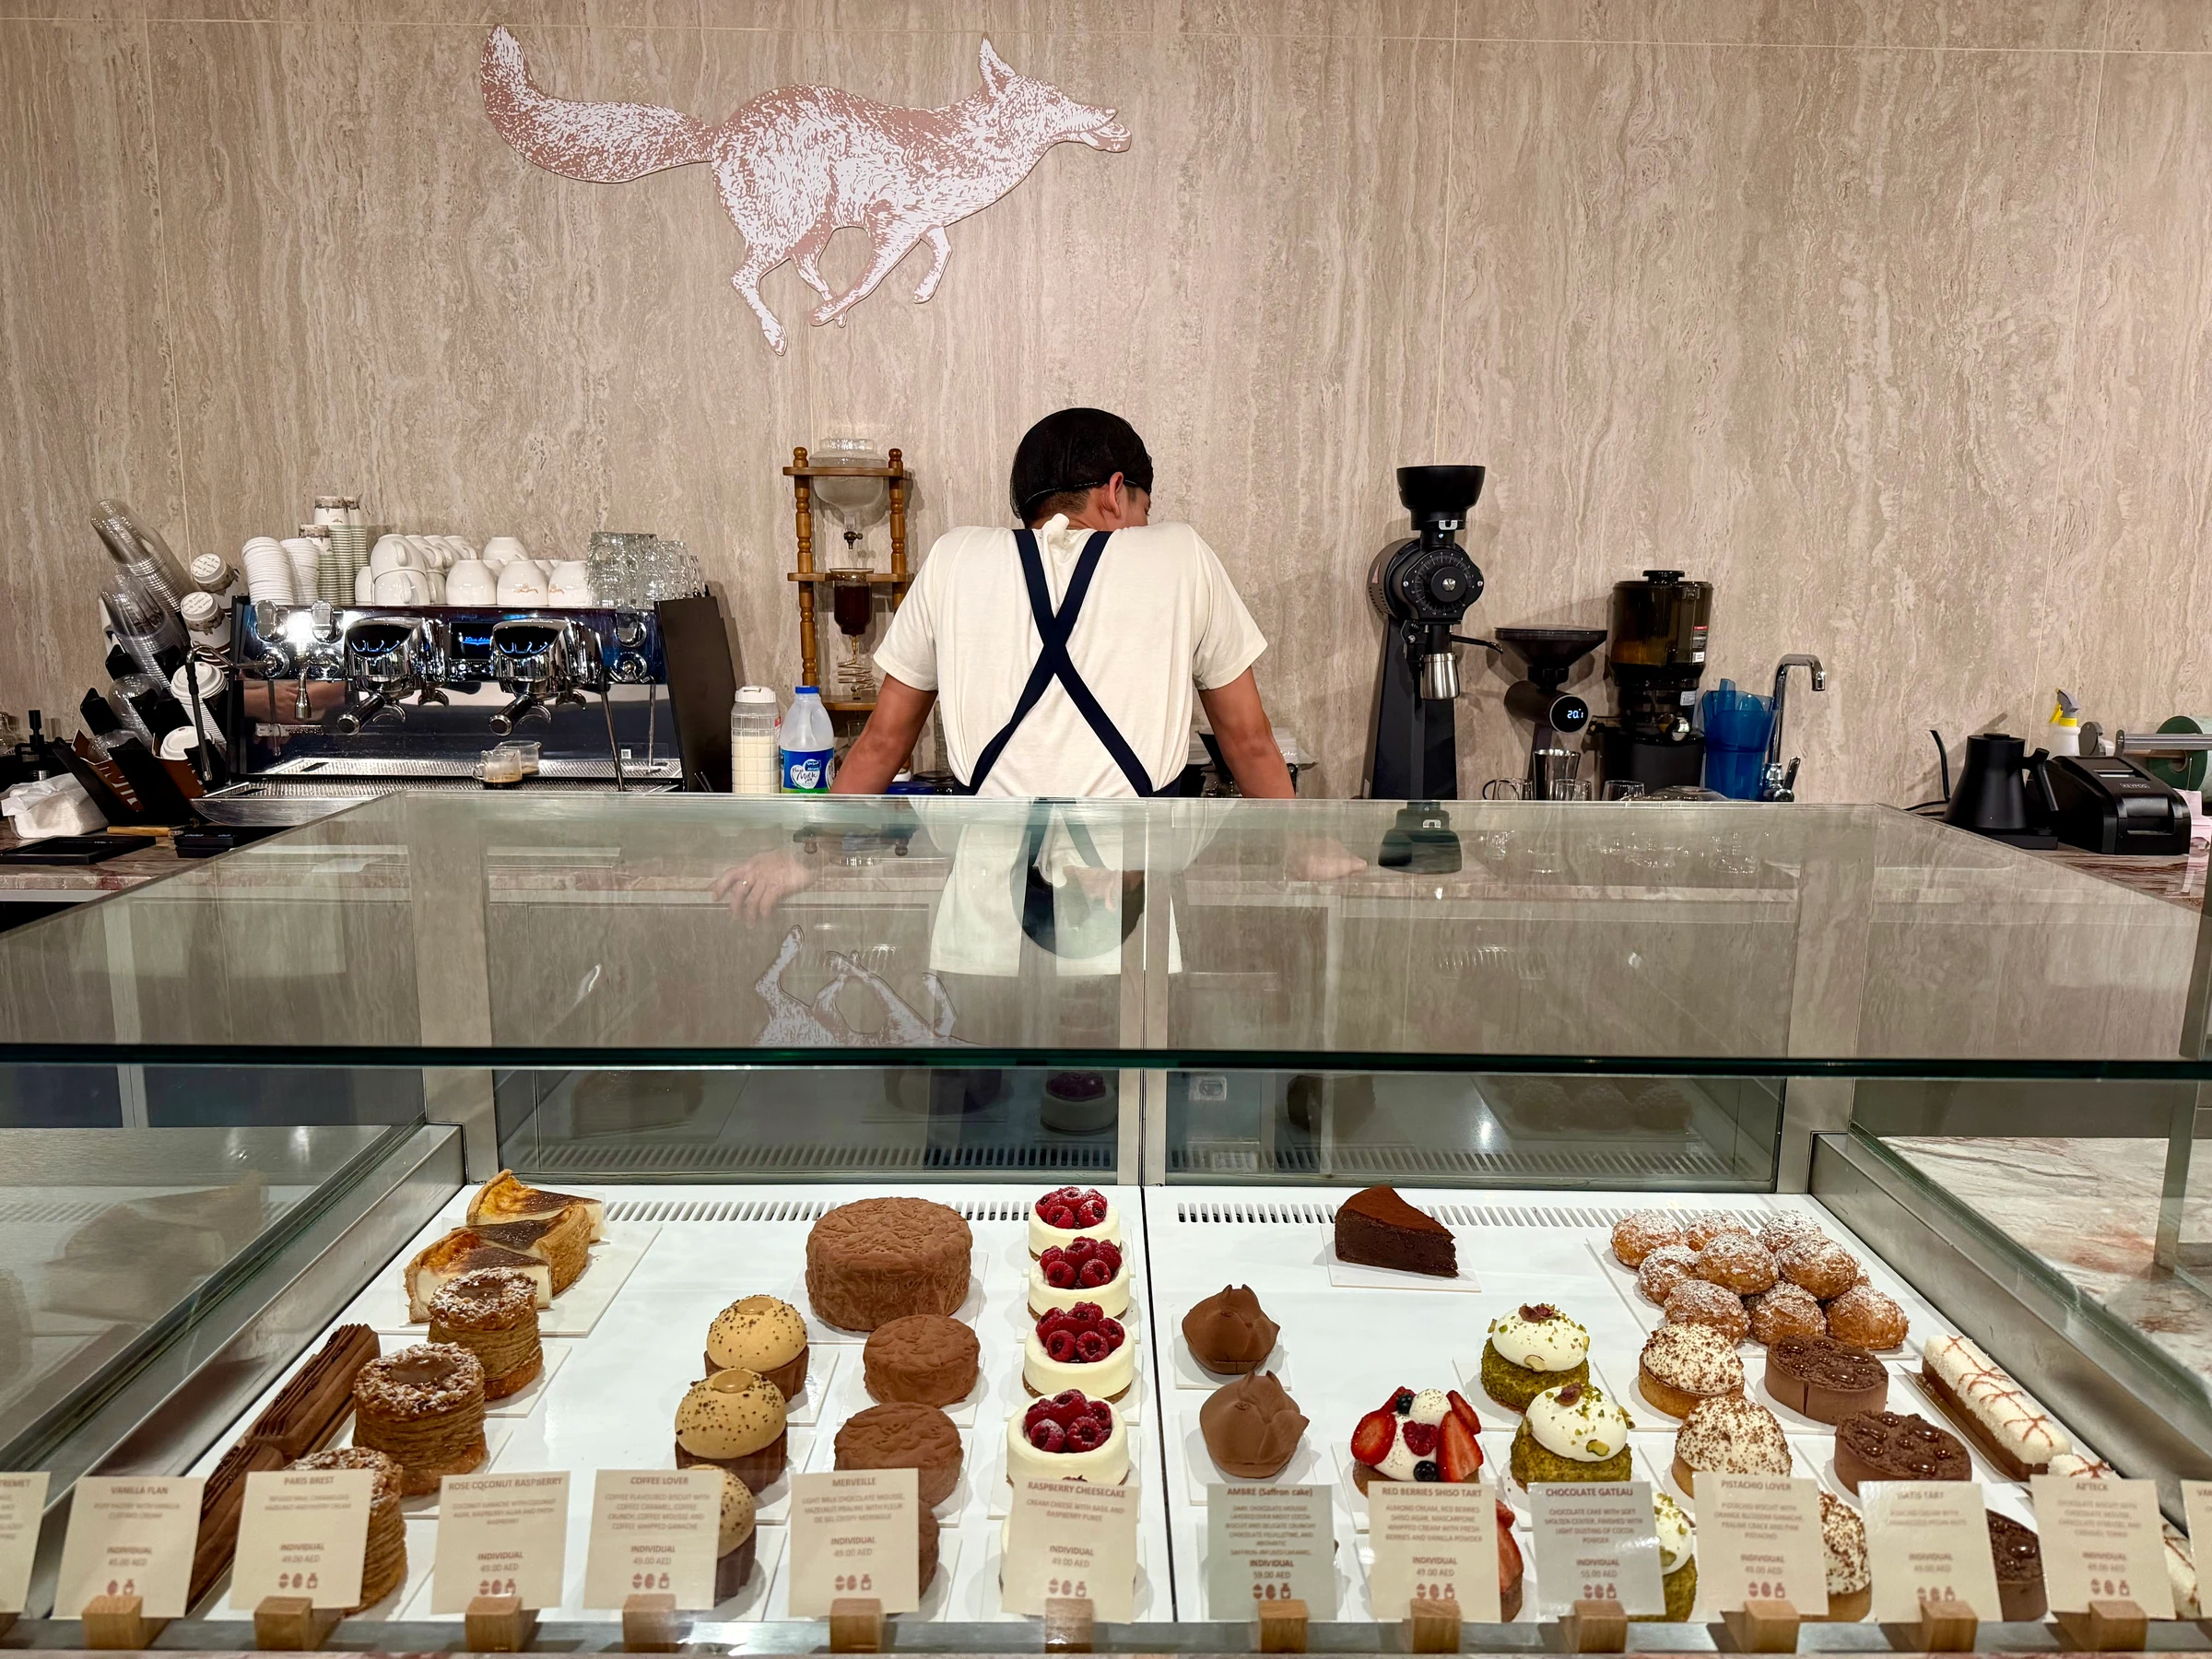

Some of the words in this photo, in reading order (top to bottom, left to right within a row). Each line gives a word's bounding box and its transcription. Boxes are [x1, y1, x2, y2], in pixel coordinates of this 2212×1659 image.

[796, 771, 818, 781] Milk
[310, 1476, 335, 1485] BREST
[448, 1482, 469, 1490] ROSE
[472, 1479, 513, 1490] COCONUT
[514, 1477, 562, 1487] RASPBERRY
[630, 1477, 660, 1485] COFFEE
[663, 1477, 689, 1485] LOVER
[832, 1477, 876, 1487] MERVEILLE
[1028, 1481, 1074, 1493] RASPBERRY
[1076, 1485, 1126, 1498] CHEESECAKE
[1721, 1480, 1764, 1490] PISTACHIO
[1765, 1482, 1791, 1491] LOVER
[1259, 1488, 1289, 1496] (Saffron
[1292, 1488, 1313, 1496] cake)
[1382, 1487, 1399, 1495] RED
[1401, 1487, 1433, 1496] BERRIES
[1461, 1489, 1482, 1497] TART
[1546, 1488, 1596, 1496] CHOCOLATE
[1598, 1488, 1633, 1496] GATEAU
[1047, 1511, 1081, 1519] RASPBERRY
[831, 1537, 876, 1545] INDIVIDUAL
[1049, 1545, 1094, 1556] INDIVIDUAL
[305, 1554, 320, 1563] AED
[477, 1552, 523, 1560] INDIVIDUAL
[1740, 1554, 1785, 1563] INDIVIDUAL
[2082, 1551, 2127, 1560] INDIVIDUAL
[1052, 1558, 1073, 1566] 49.00
[1074, 1559, 1090, 1567] AED
[1412, 1557, 1457, 1565] INDIVIDUAL
[503, 1563, 519, 1571] AED
[1767, 1567, 1783, 1575] AED
